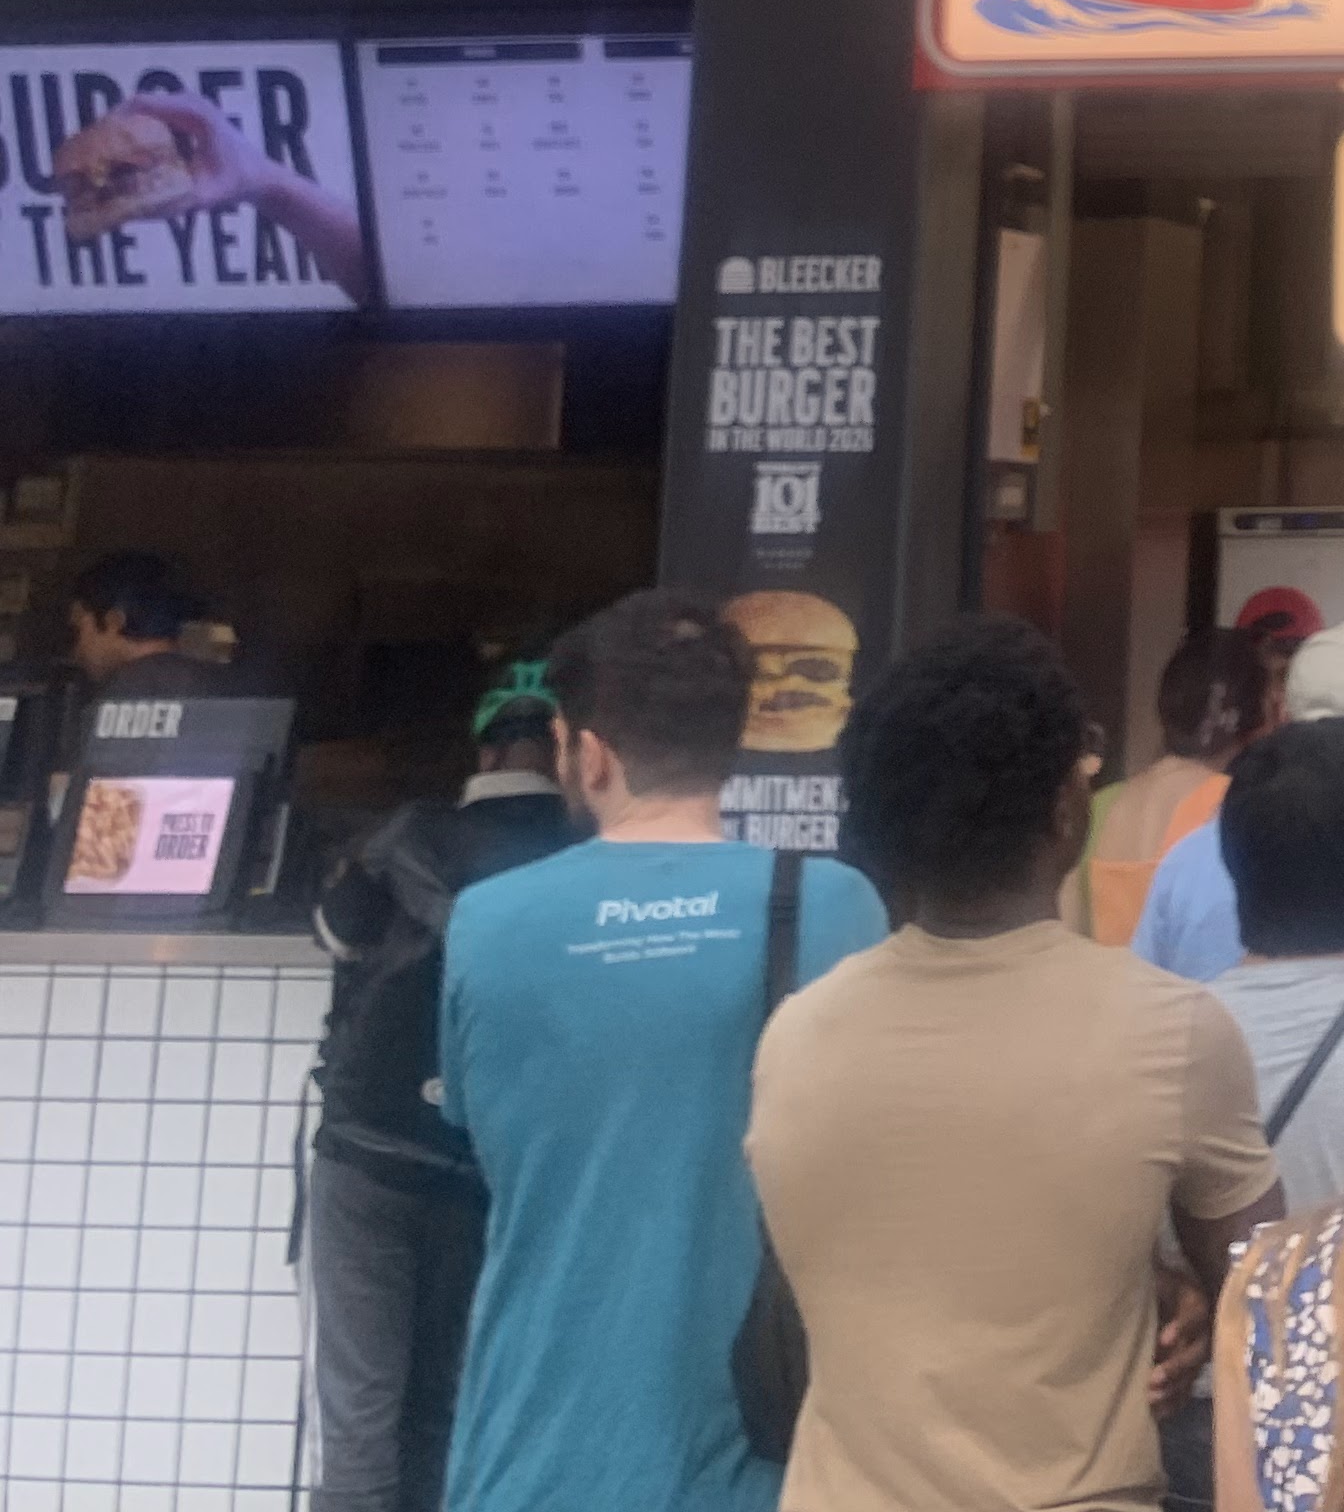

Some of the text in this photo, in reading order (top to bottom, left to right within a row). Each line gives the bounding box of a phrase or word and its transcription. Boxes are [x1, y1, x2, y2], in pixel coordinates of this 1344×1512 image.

[165, 205, 331, 285] YEA
[759, 254, 882, 293] BLEECKER
[714, 316, 881, 368] THE BEST
[709, 367, 877, 426] BURGER
[732, 426, 764, 452] THE
[97, 703, 183, 738] ORDER
[747, 814, 840, 851] BURGER
[596, 890, 719, 926] Pivotal
